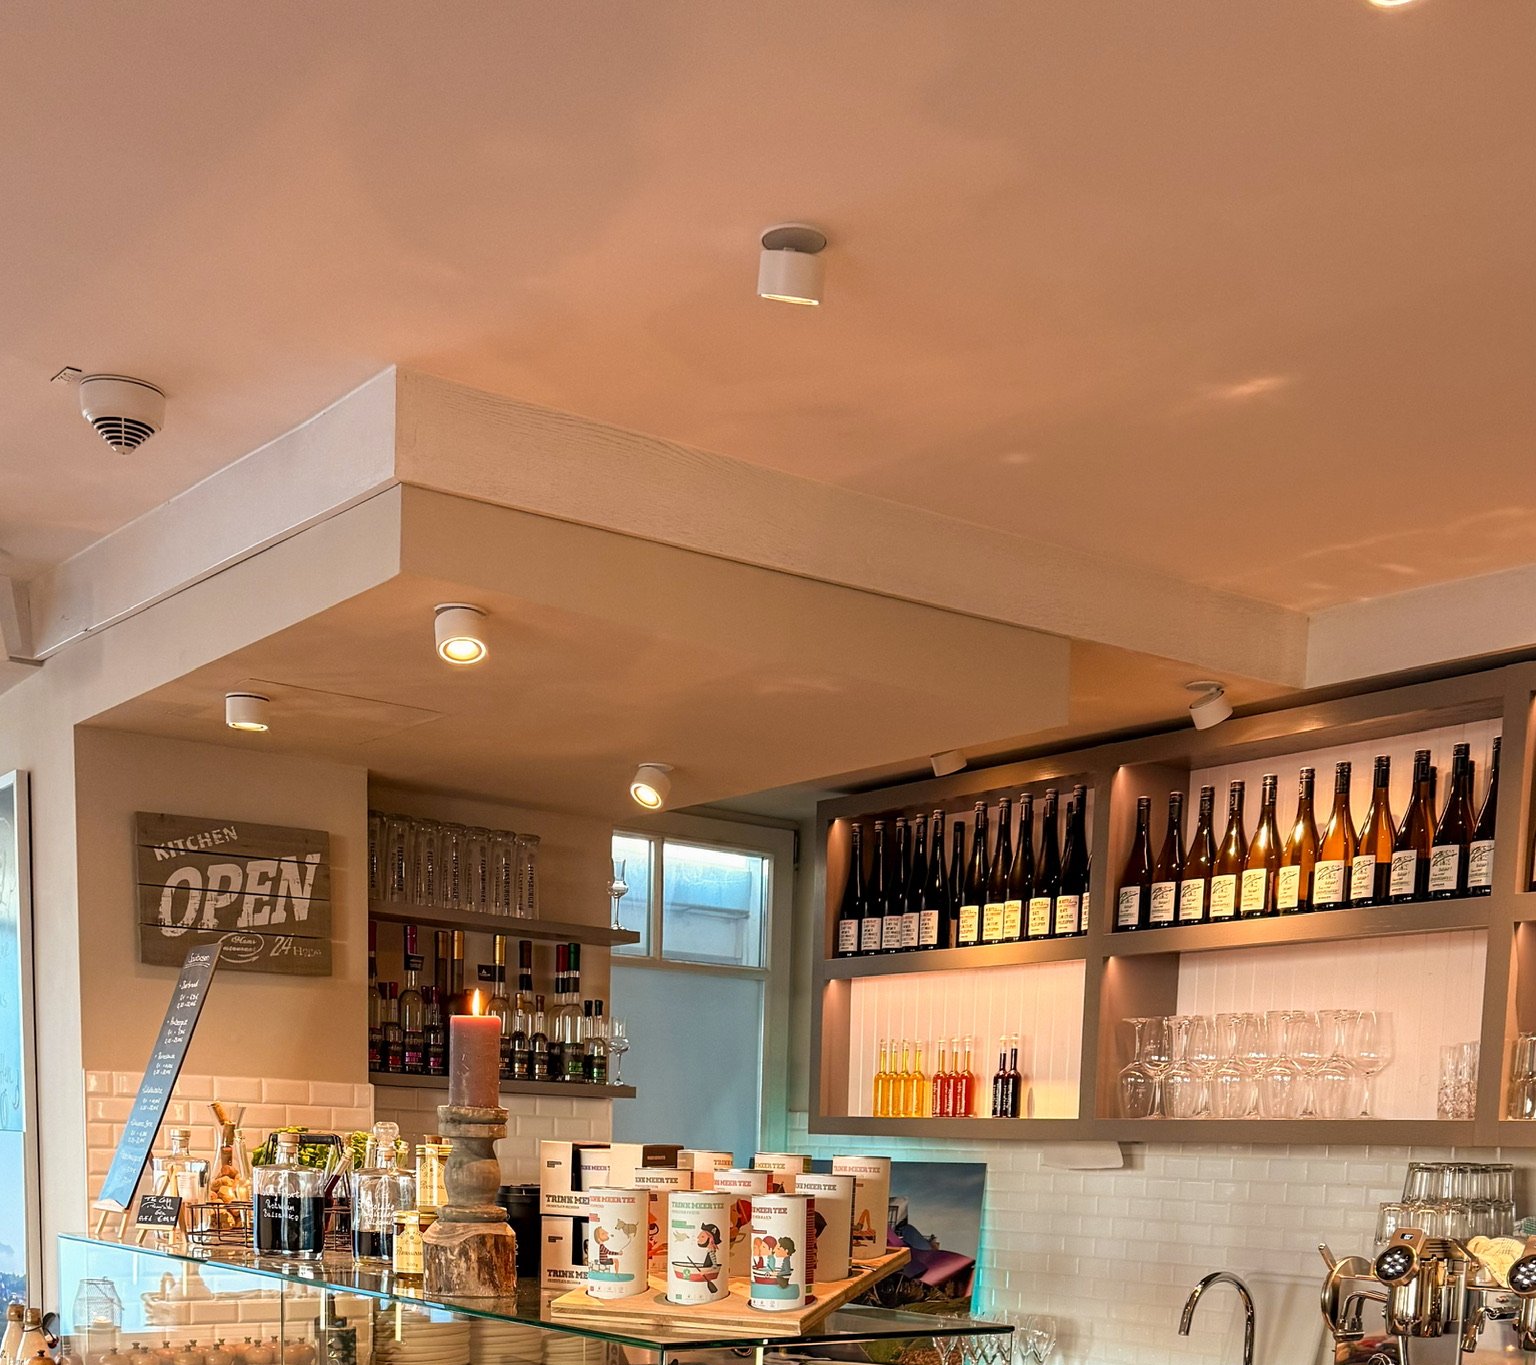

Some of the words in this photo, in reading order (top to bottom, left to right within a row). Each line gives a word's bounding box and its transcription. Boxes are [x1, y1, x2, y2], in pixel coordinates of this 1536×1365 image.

[153, 825, 238, 862] KITCHEN
[157, 853, 321, 938] OPEN
[270, 934, 293, 956] 24
[546, 1194, 574, 1204] TRINK
[547, 1269, 575, 1279] TRINK
